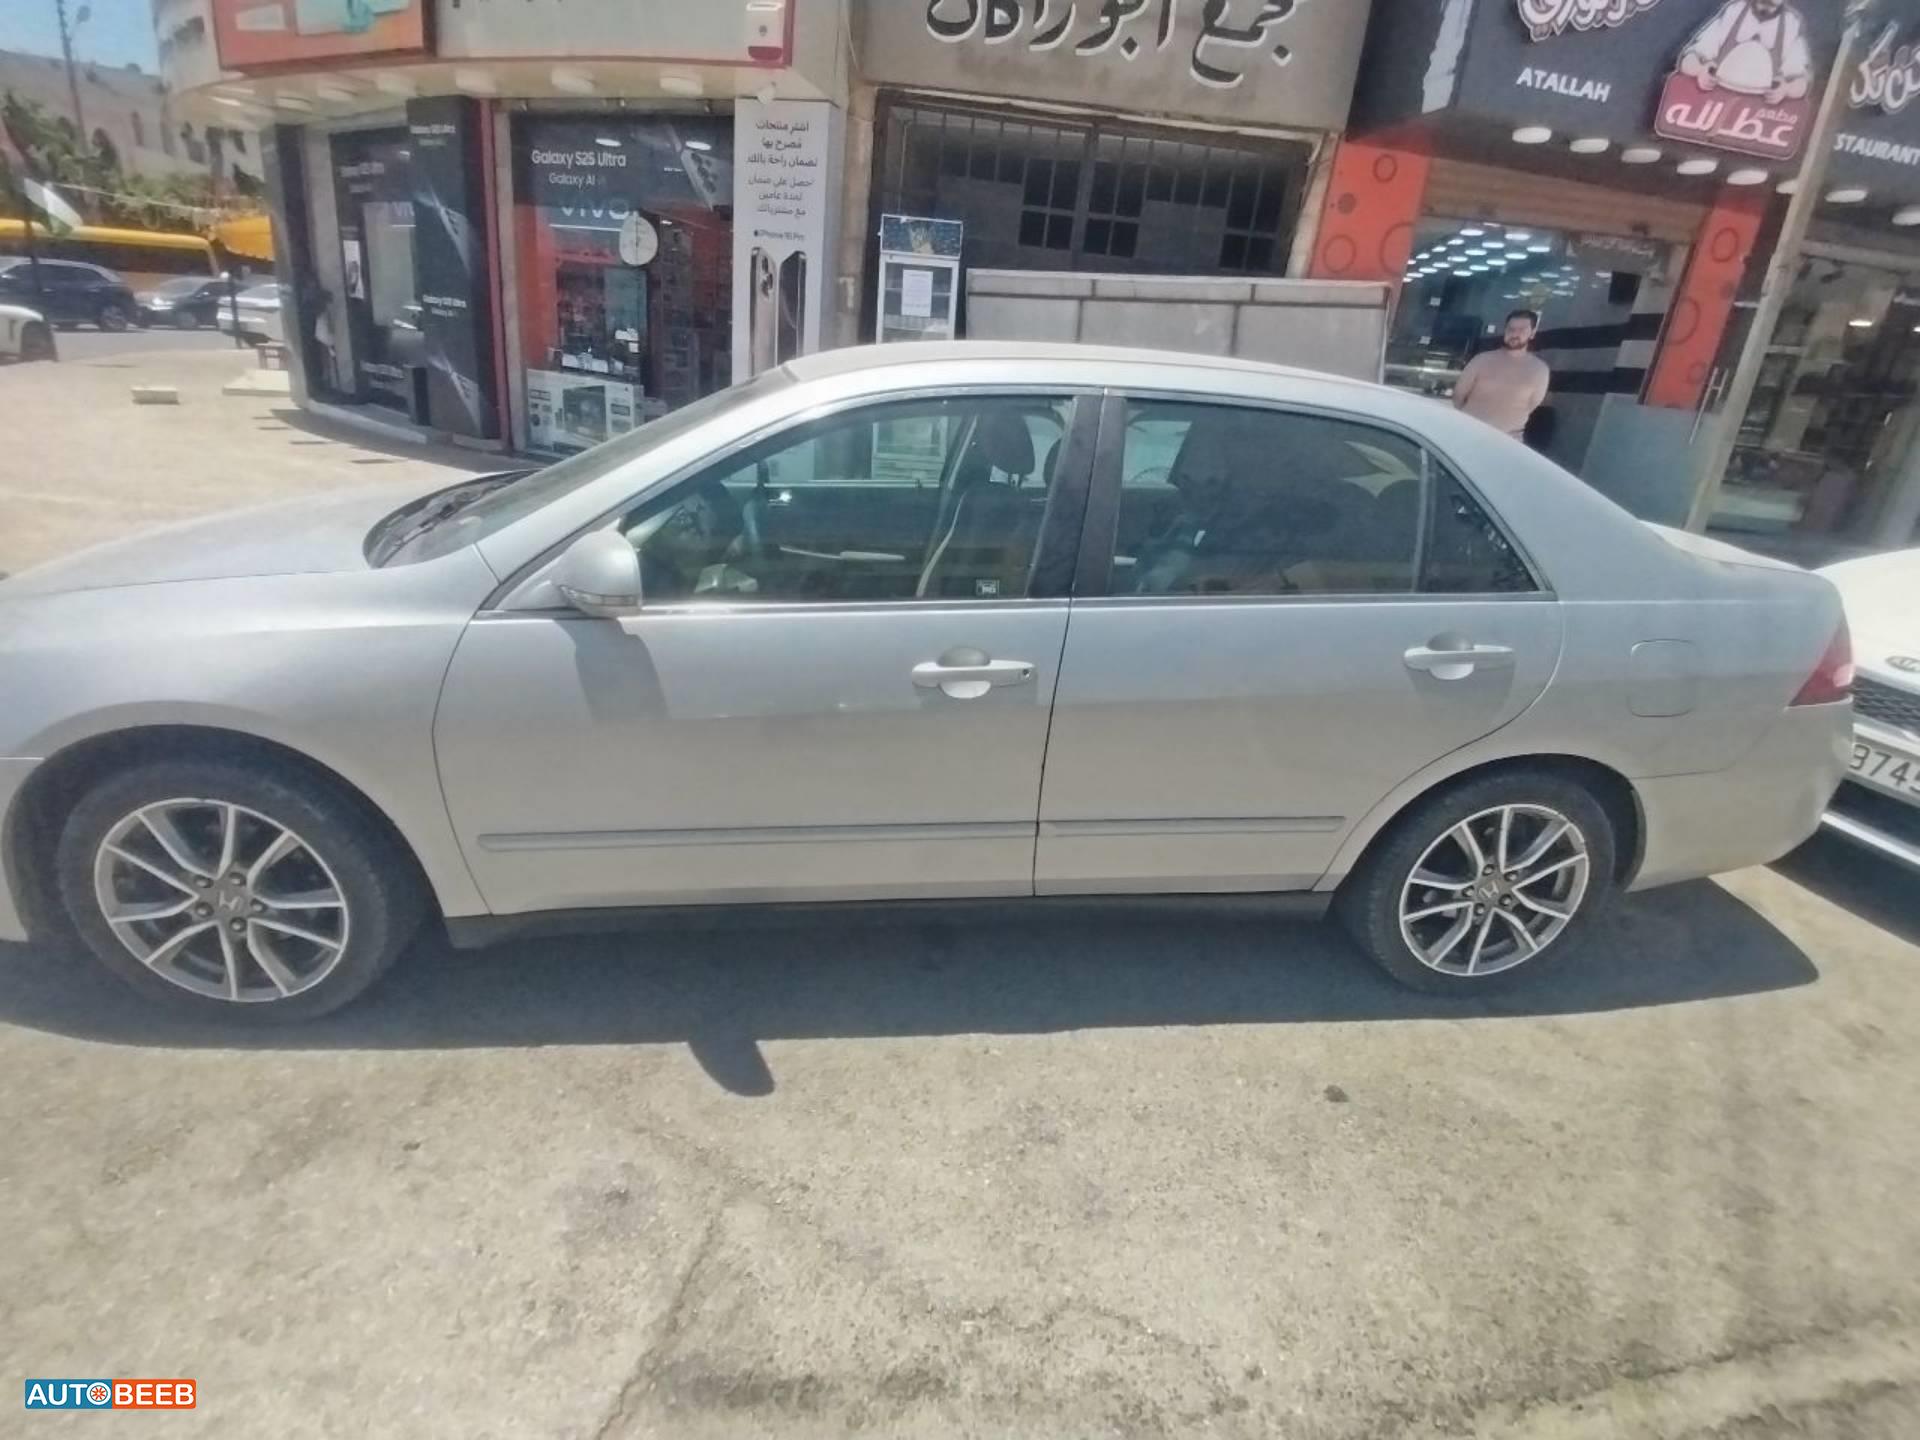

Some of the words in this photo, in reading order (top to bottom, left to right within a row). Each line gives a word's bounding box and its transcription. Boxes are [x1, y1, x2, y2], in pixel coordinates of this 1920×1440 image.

[1516, 67, 1611, 102] ATALLAH
[531, 150, 573, 169] Galaxy
[575, 152, 595, 167] S25
[597, 151, 627, 168] Ultra
[549, 172, 584, 188] Galaxy
[586, 174, 596, 186] AI
